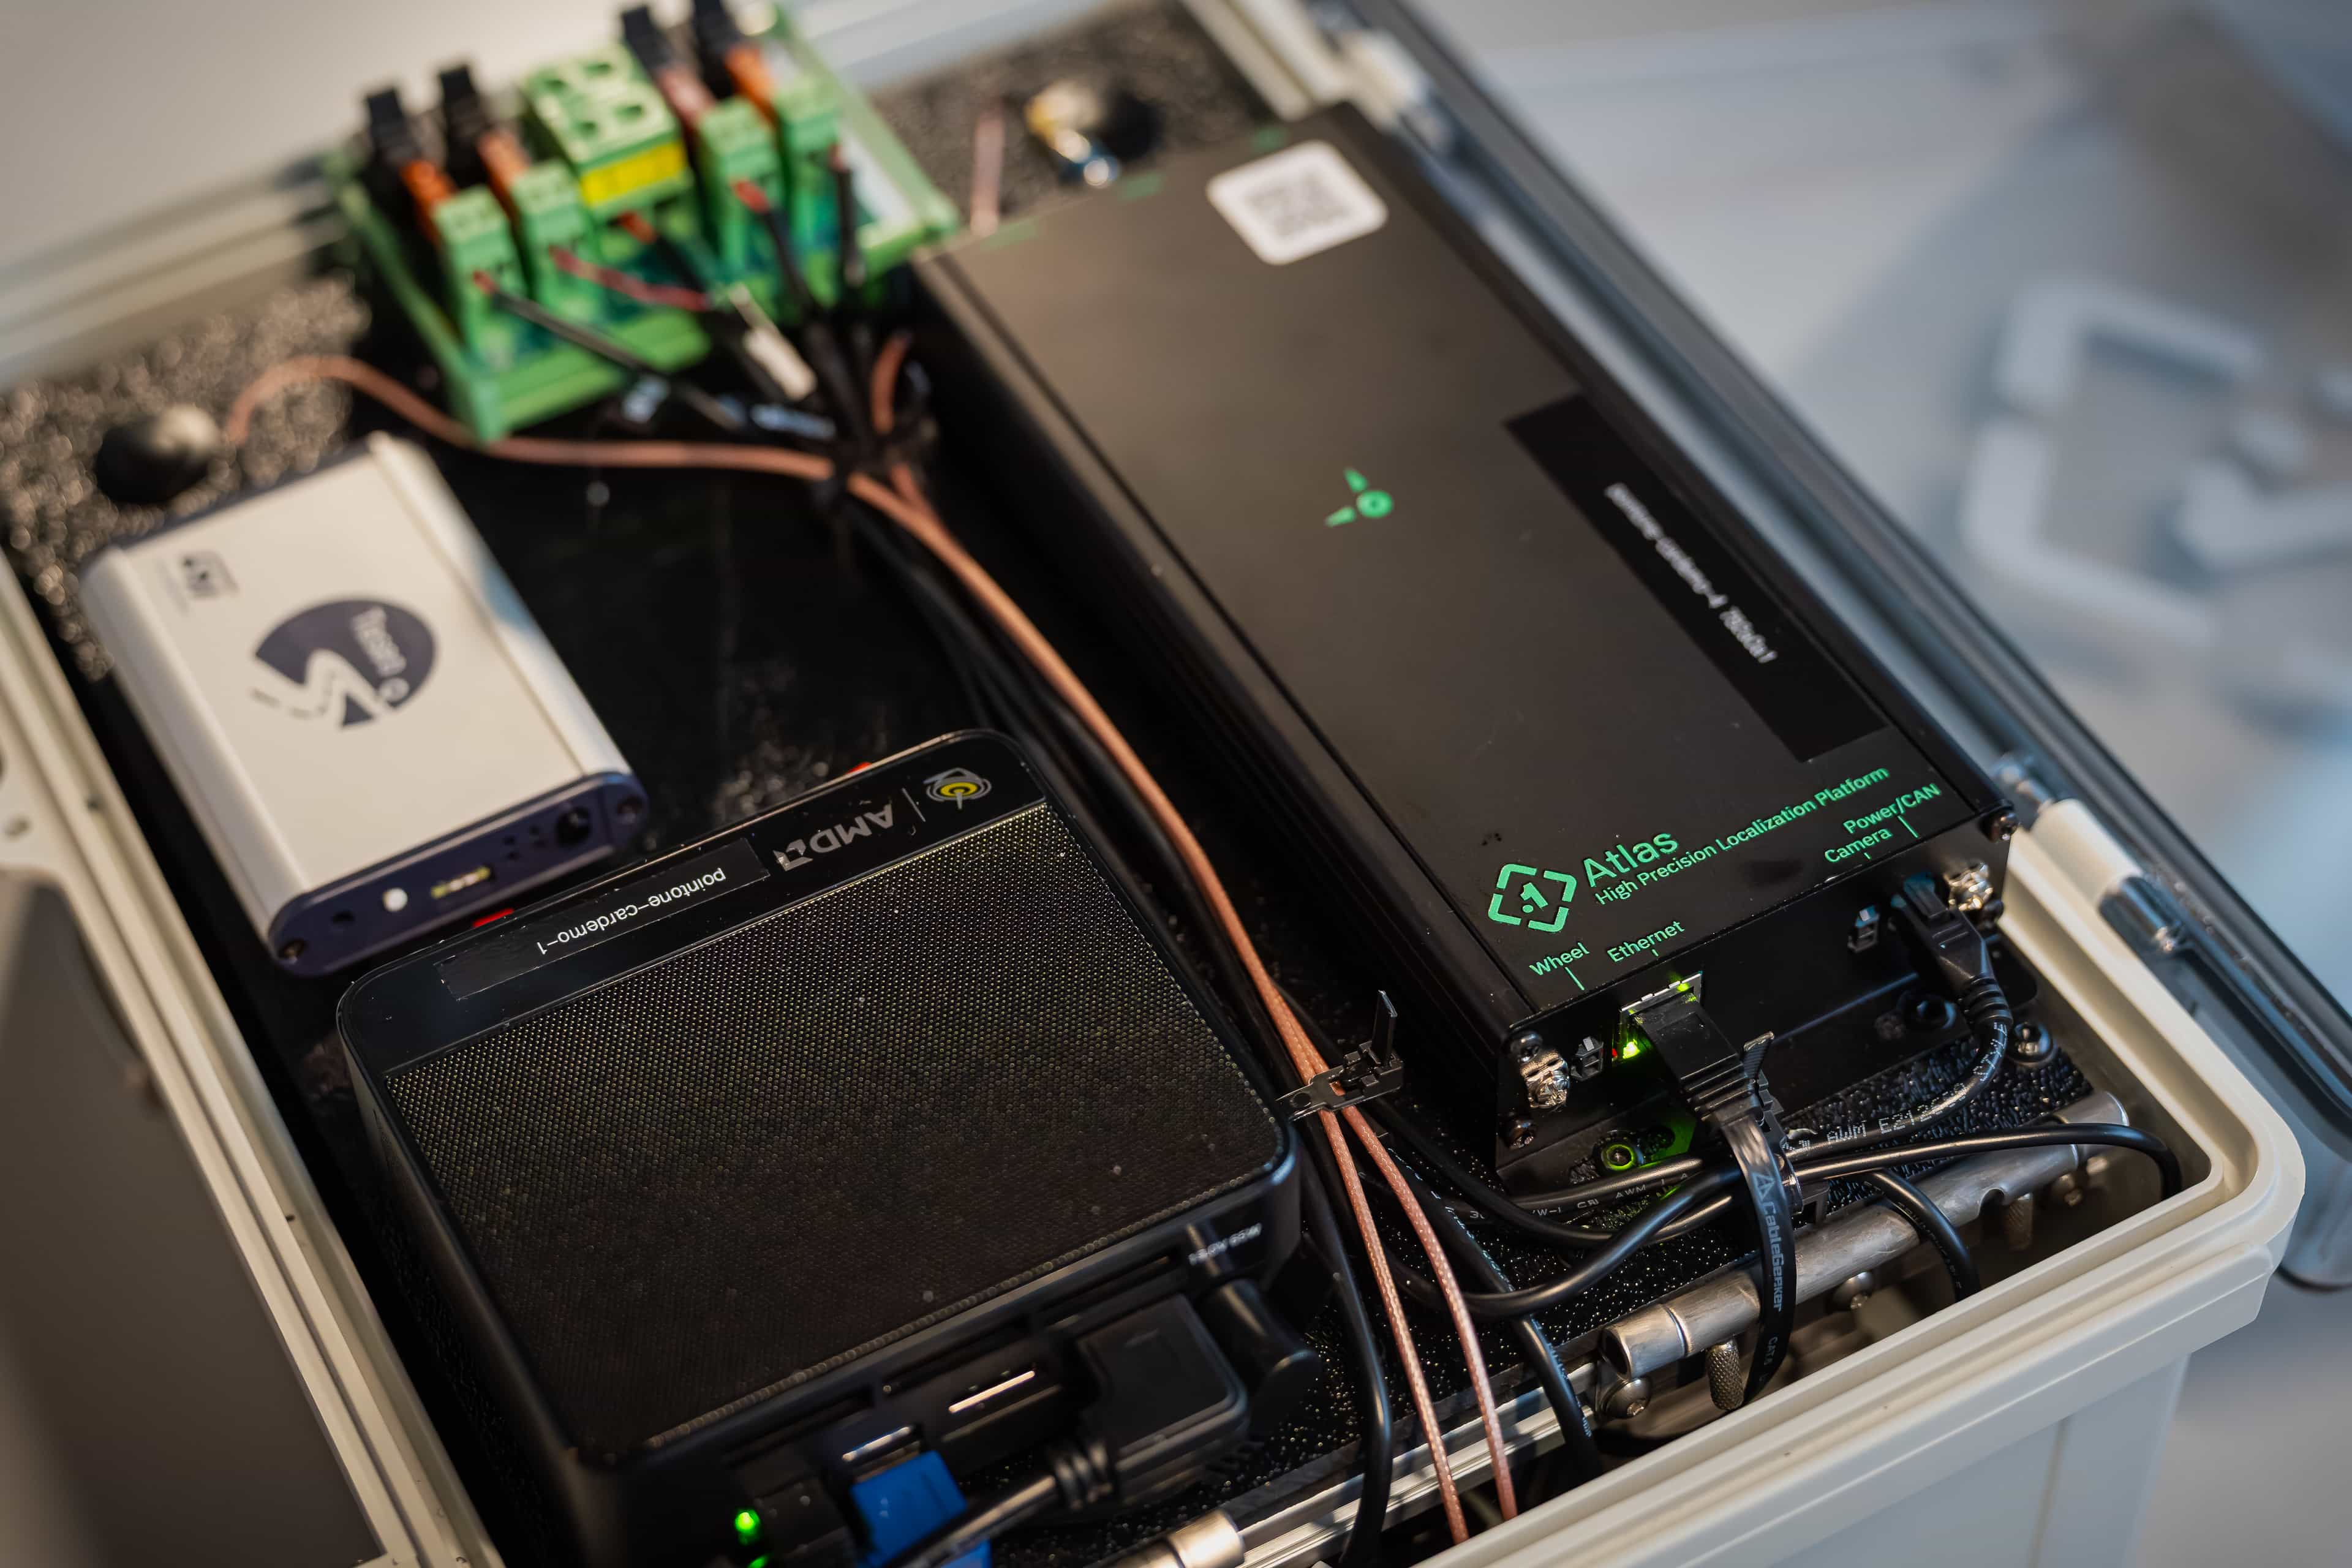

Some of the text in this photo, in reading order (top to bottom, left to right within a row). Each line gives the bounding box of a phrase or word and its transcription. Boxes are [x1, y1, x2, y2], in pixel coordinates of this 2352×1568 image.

[809, 803, 894, 853] AMD
[1843, 783, 1941, 834] Power/CAN
[1584, 832, 1678, 887] Atlas
[1594, 767, 1889, 905] High Precision Localization Platform
[1825, 828, 1892, 862] Camera
[537, 867, 726, 956] pointone-cardemo-1
[1529, 941, 1590, 975] Wheel
[1607, 921, 1684, 962] Ethernet
[1826, 1122, 1867, 1144] AWM
[1762, 1201, 1785, 1312] CableGeeker
